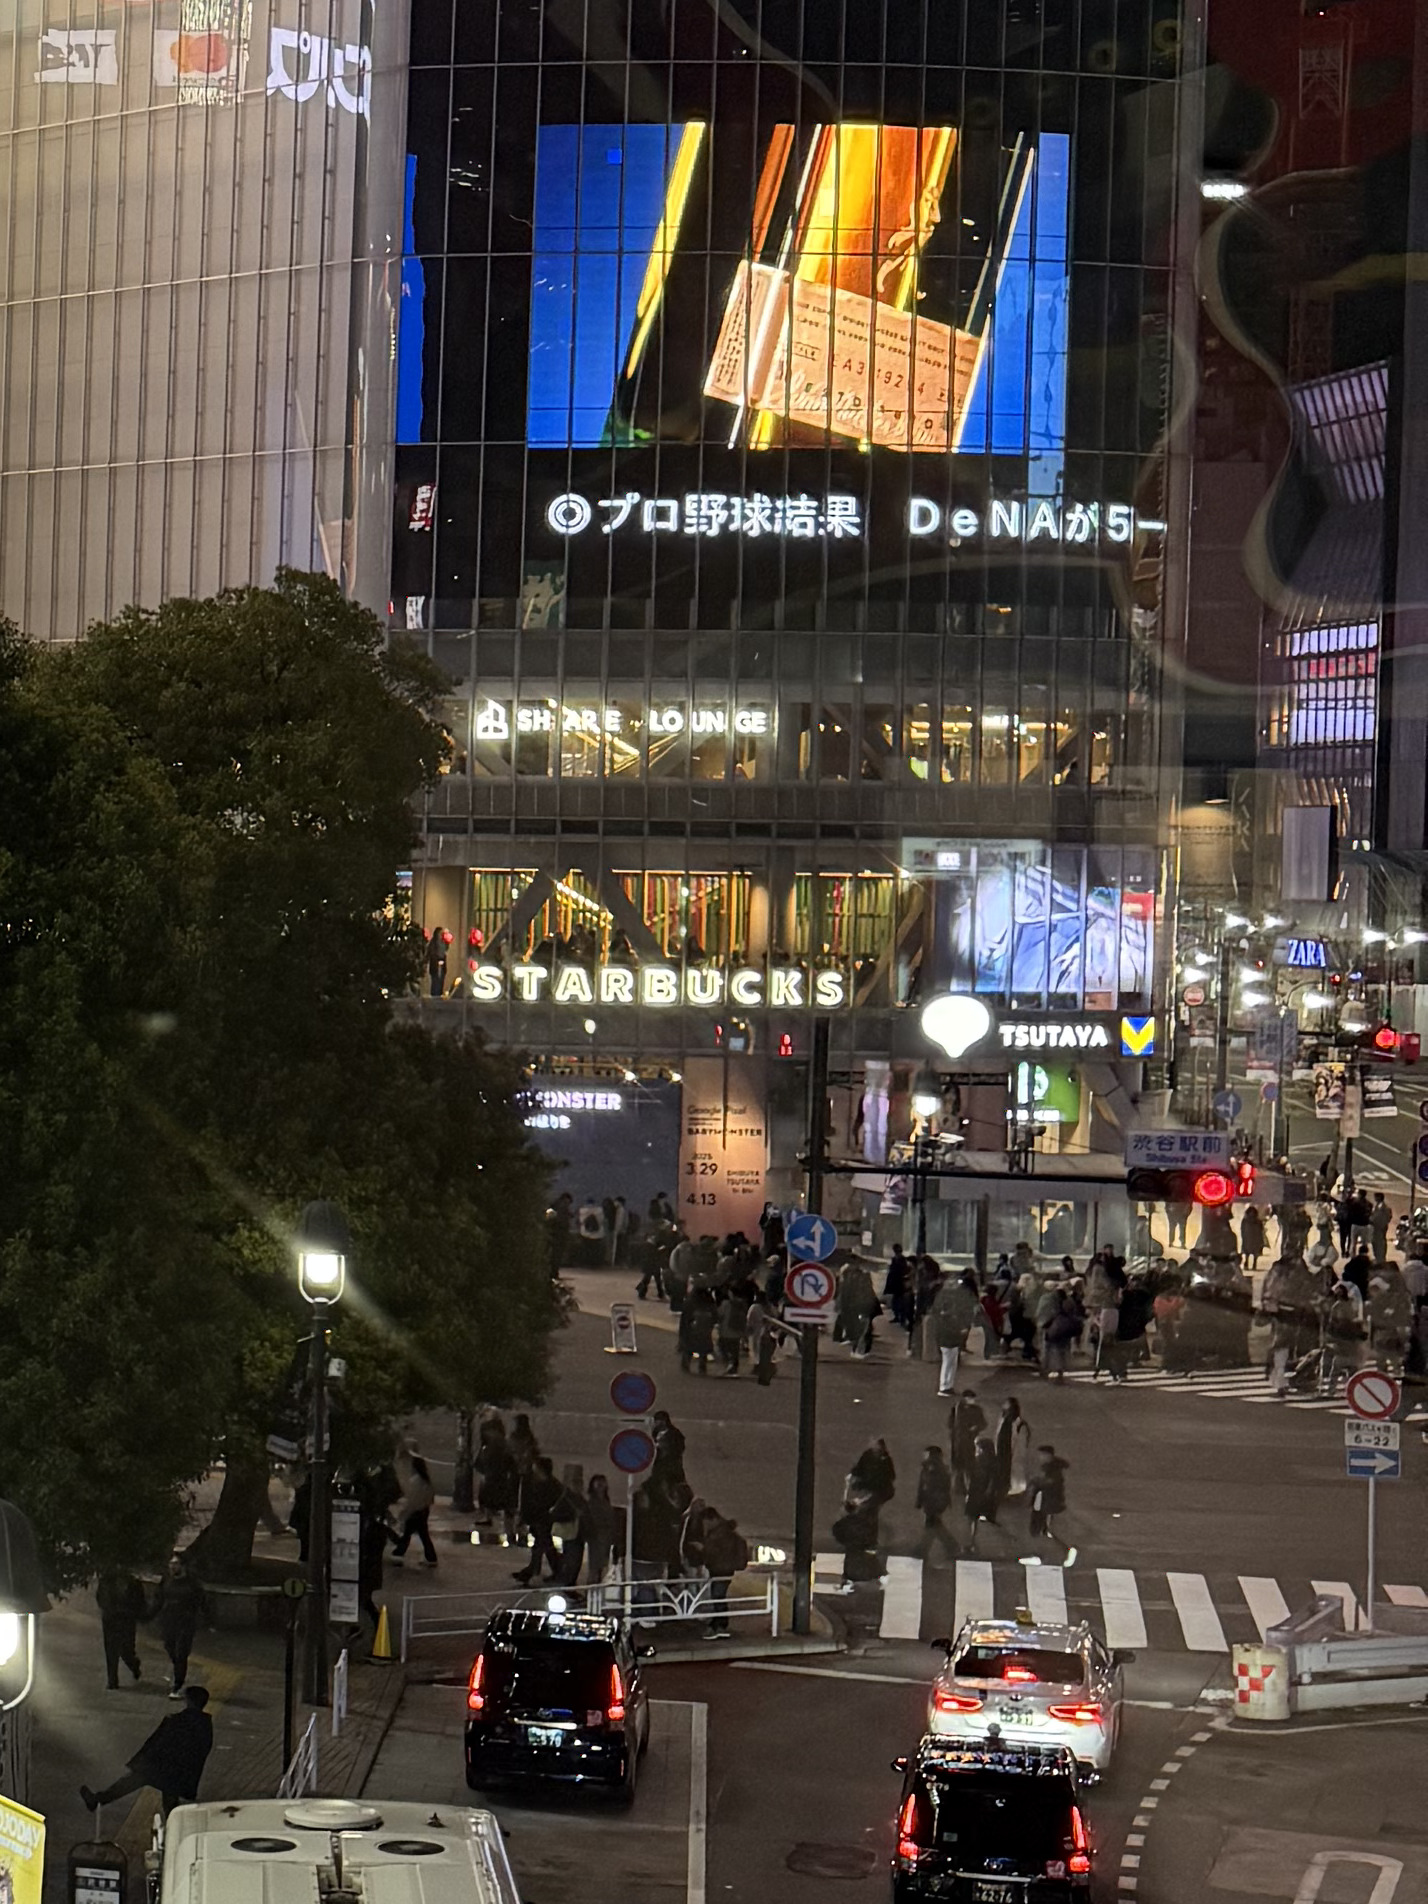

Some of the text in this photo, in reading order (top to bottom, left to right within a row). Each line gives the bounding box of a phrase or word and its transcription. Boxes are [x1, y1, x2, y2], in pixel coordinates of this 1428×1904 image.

[1287, 939, 1326, 968] ZARA
[472, 965, 844, 1007] STARBUCKS
[999, 1024, 1109, 1048] TSUTAYA
